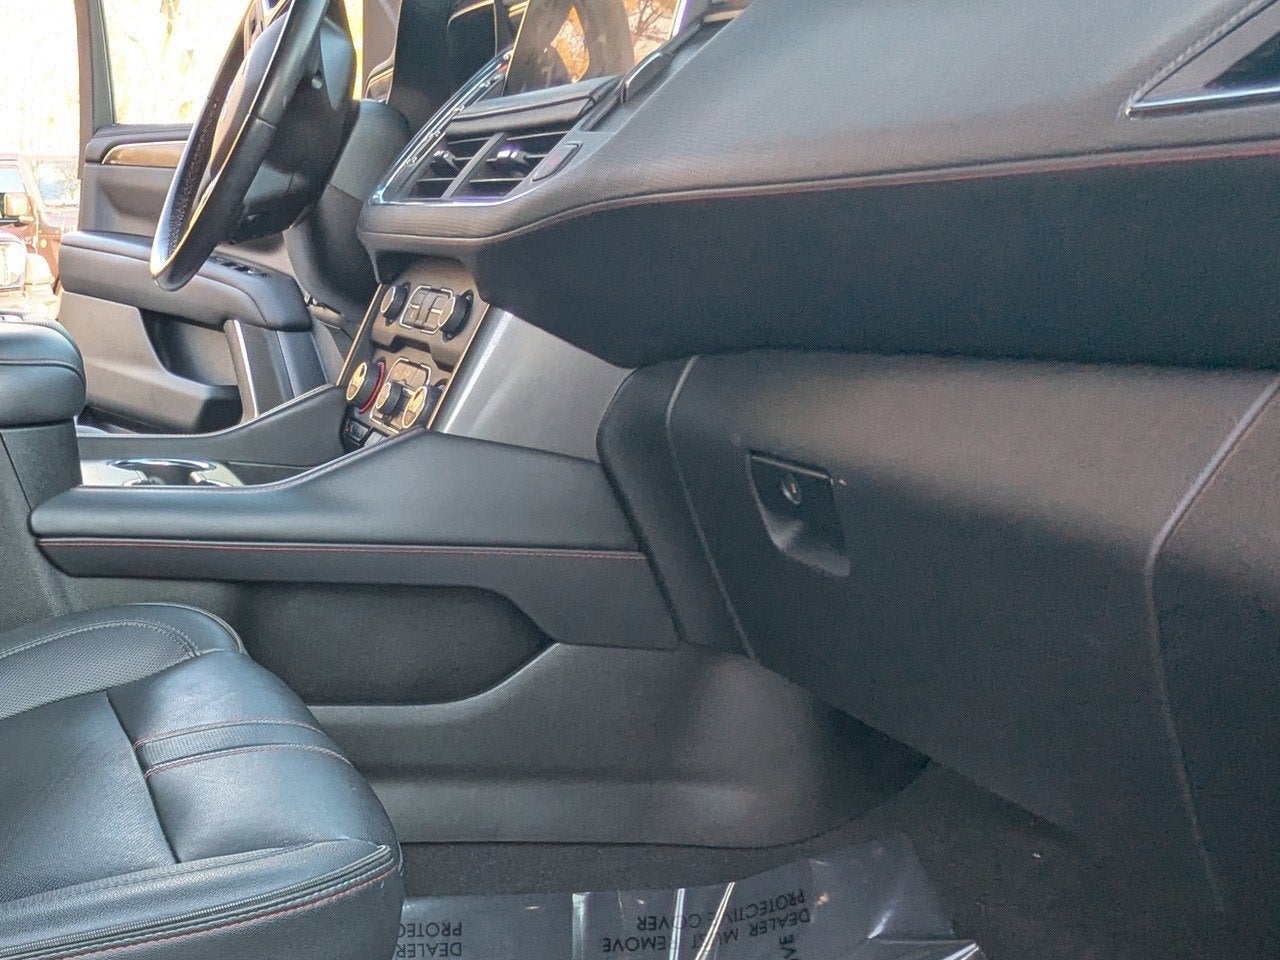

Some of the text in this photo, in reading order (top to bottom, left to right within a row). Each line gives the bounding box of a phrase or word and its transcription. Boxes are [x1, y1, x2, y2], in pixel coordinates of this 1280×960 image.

[748, 908, 811, 938] DEALER
[396, 941, 463, 958] DEALER
[602, 936, 668, 951] EMOVE
